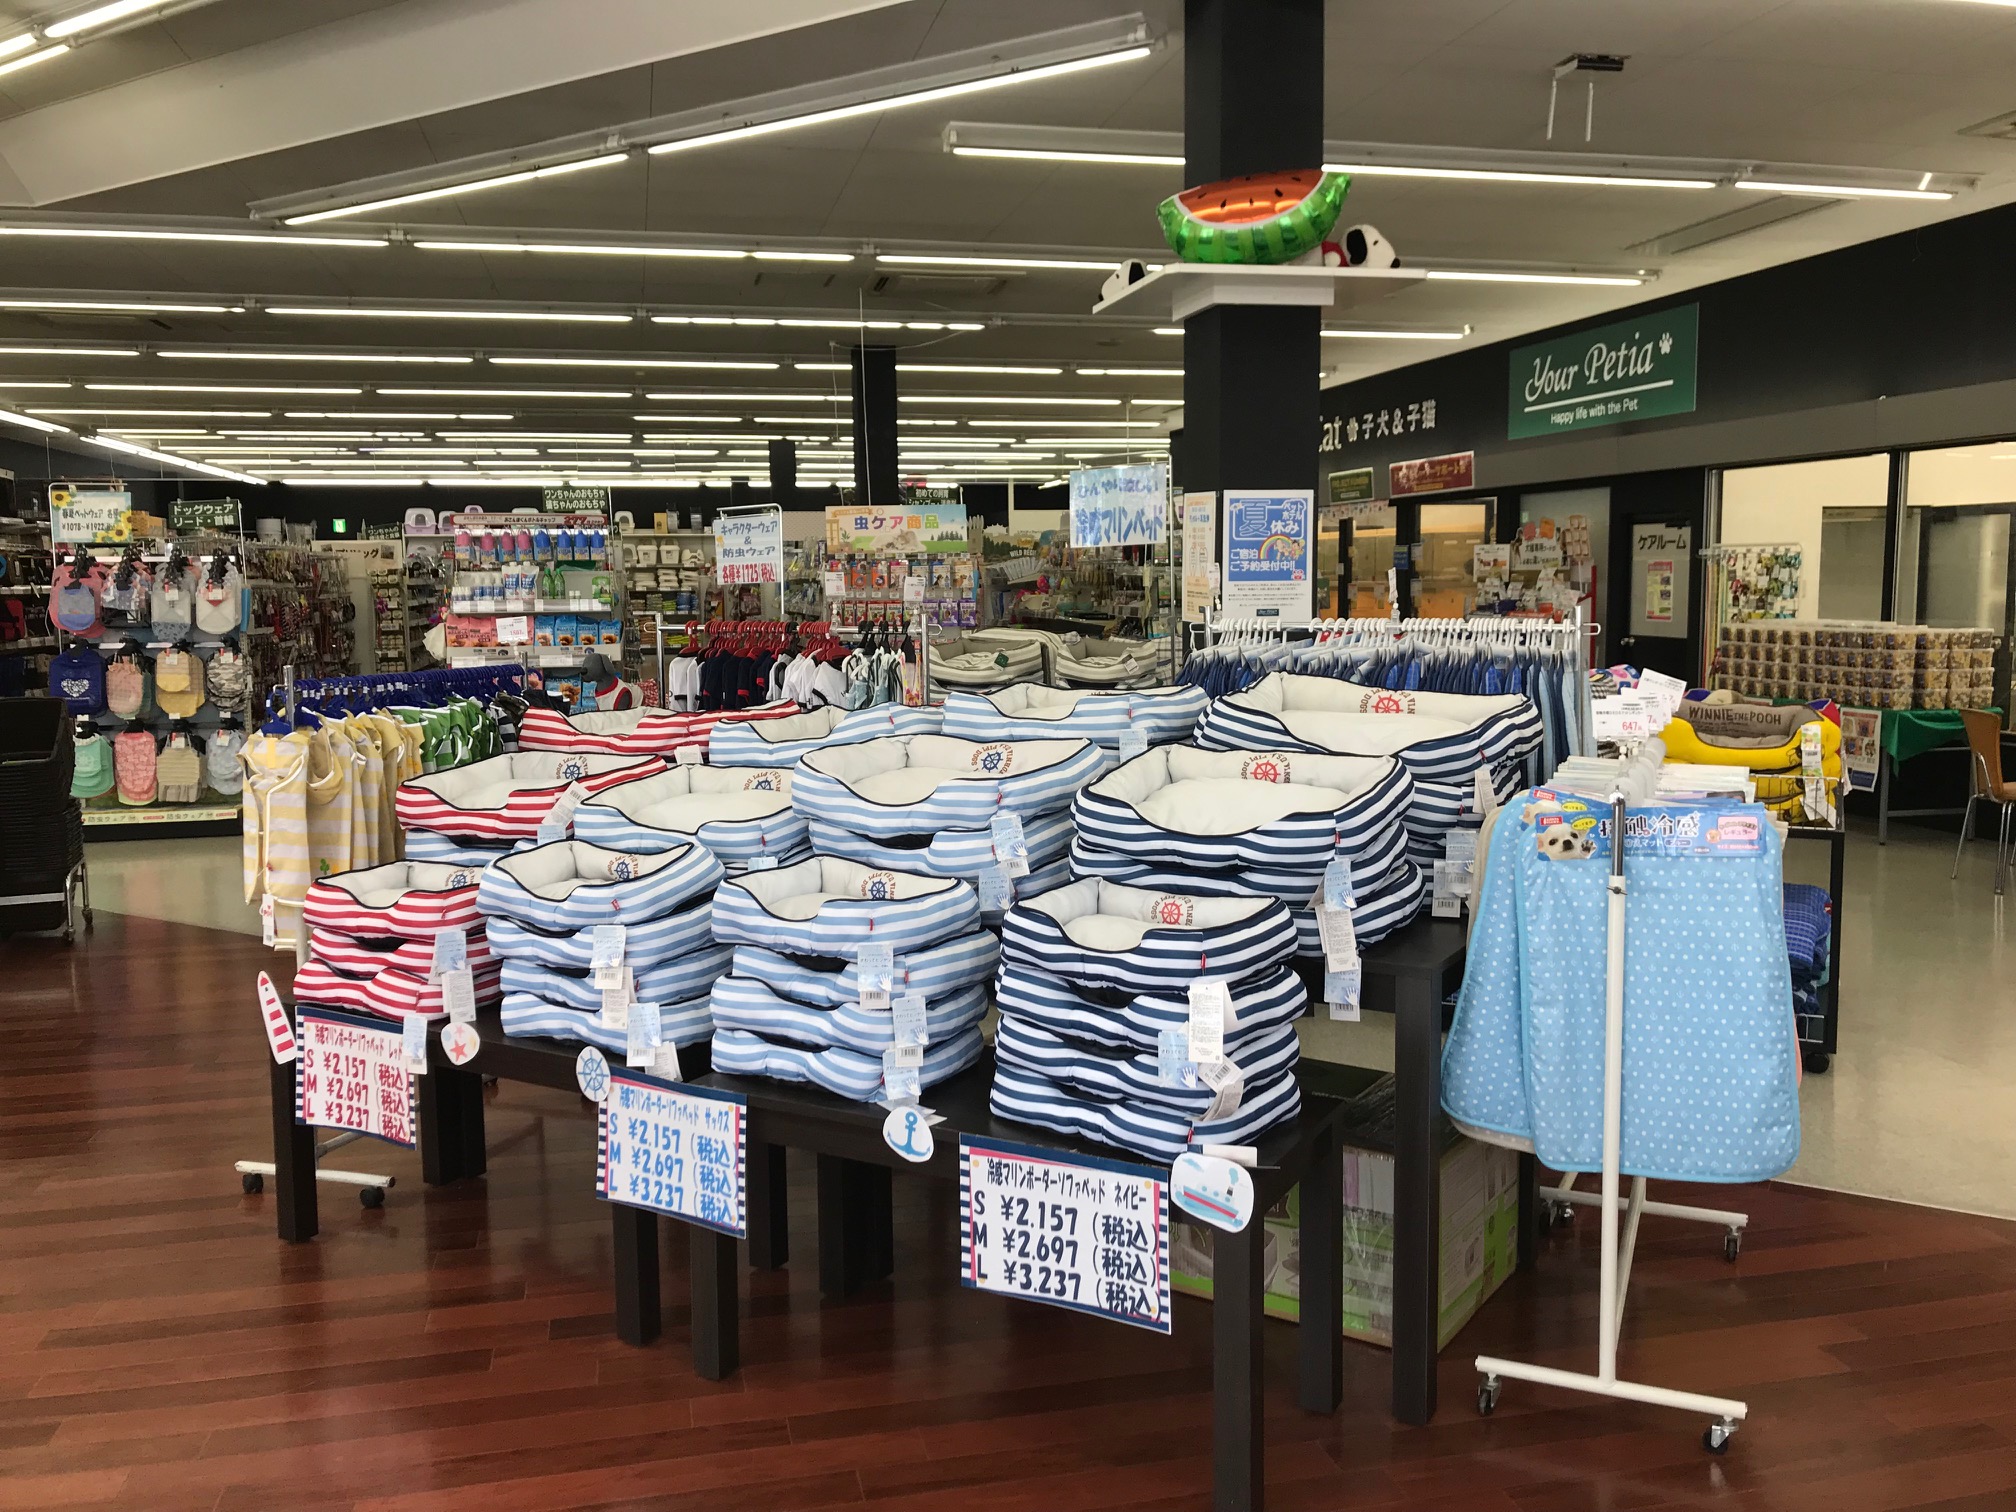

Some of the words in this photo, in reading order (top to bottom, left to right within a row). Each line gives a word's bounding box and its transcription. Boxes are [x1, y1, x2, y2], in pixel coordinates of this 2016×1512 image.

[1525, 354, 1578, 402] Your
[1584, 331, 1655, 385] Petia
[1551, 410, 1574, 425] Happy
[1575, 406, 1587, 420] life
[1589, 404, 1606, 418] with
[1607, 400, 1621, 414] the
[1622, 397, 1638, 412] Pet
[544, 489, 606, 499] ワンちゃんのおもちゃ
[173, 503, 233, 516] ドッグウェア
[545, 499, 606, 510] 猫ちゃんのおもちゃ
[1283, 502, 1304, 511] ペット
[174, 515, 235, 527] リード・首輪
[721, 520, 778, 536] キャラクターウェア
[854, 514, 940, 530] 虫ケア商品
[744, 536, 752, 545] &
[1637, 534, 1687, 551] ケアルーム
[722, 546, 776, 558] 防虫ウェア
[1230, 548, 1259, 559] ご宿泊
[1688, 706, 1733, 721] WINNIE
[1732, 712, 1749, 721] THE
[1749, 711, 1782, 725] POOH
[306, 1048, 314, 1068] S
[306, 1072, 318, 1093] M
[306, 1099, 315, 1119] L
[609, 1112, 618, 1135] S
[704, 1107, 730, 1134] サックス
[609, 1140, 622, 1164] M
[609, 1169, 618, 1192] L
[986, 1157, 1106, 1205] 冷感マリンボーダーソファベッド
[1114, 1183, 1147, 1211] ネイビー
[973, 1190, 986, 1215] S
[972, 1221, 988, 1248] M
[976, 1254, 988, 1280] L
